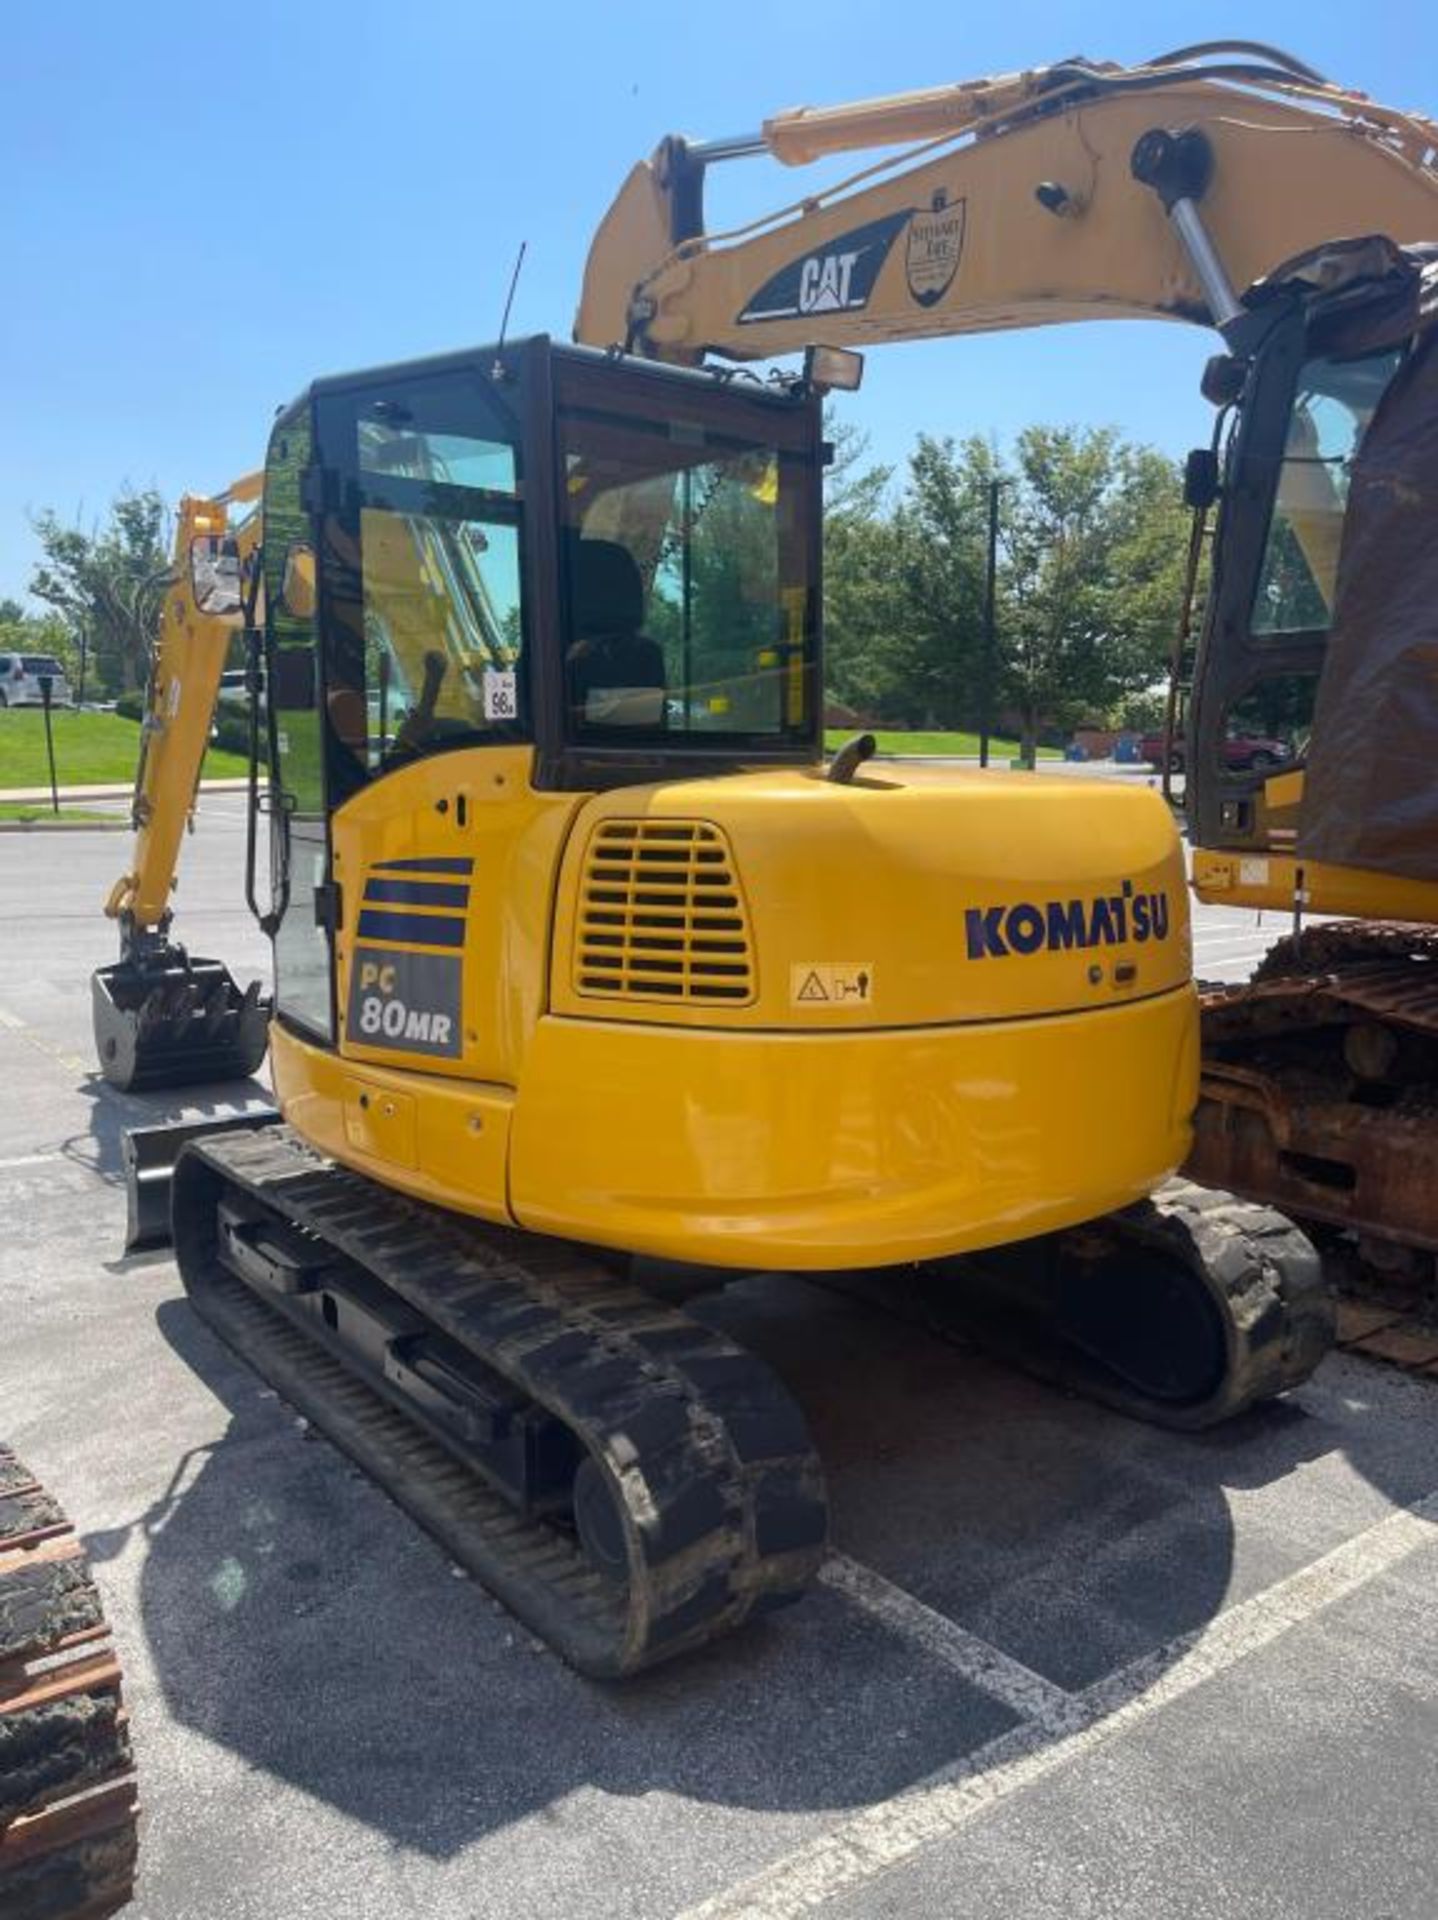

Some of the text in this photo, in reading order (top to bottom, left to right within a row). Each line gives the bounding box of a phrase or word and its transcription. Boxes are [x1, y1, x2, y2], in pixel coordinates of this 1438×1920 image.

[801, 254, 857, 312] CAT
[965, 880, 1168, 960] KOMATSU
[361, 962, 396, 993] PC
[360, 996, 451, 1043] 80MR
